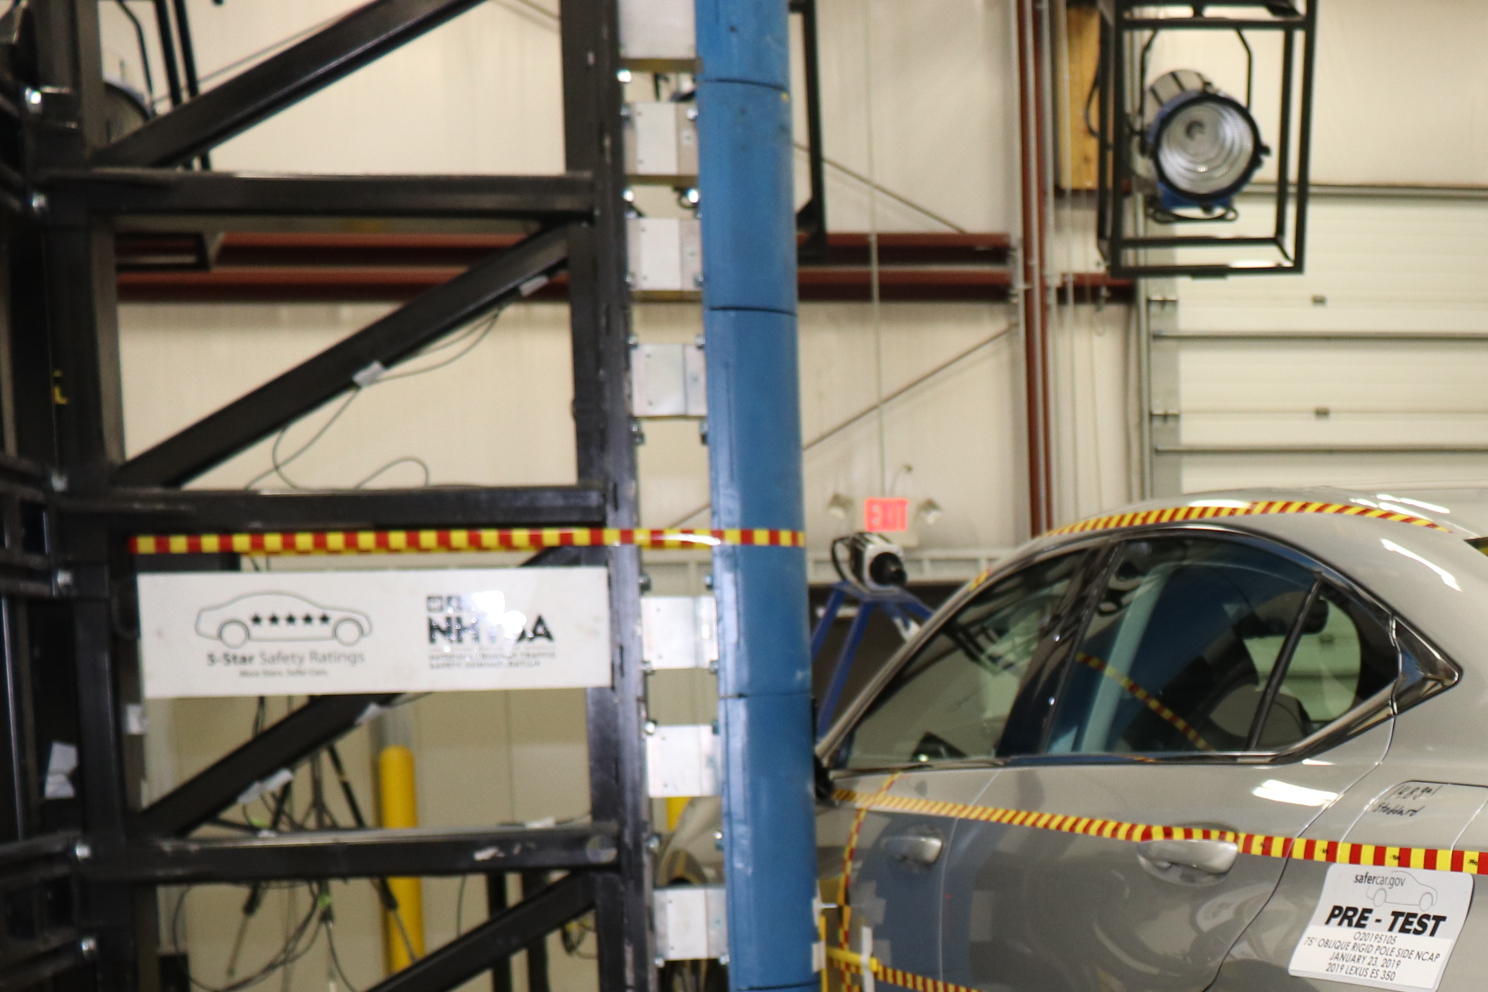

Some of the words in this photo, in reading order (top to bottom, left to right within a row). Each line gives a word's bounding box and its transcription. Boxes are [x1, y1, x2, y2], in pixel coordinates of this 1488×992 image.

[428, 613, 555, 643] NHA
[259, 651, 305, 667] Safety
[309, 650, 365, 667] Ratings
[1354, 872, 1406, 890] safercar.gov
[1325, 905, 1374, 929] PRE
[1388, 911, 1447, 937] TEST
[1318, 938, 1351, 951] OBLIQUE
[1352, 942, 1374, 954] RIGID
[1374, 945, 1396, 957] POLE
[1397, 948, 1415, 959] SIDE
[1415, 950, 1441, 963] NCAP
[1329, 952, 1367, 965] JANUARY
[1381, 958, 1401, 969] 2019
[1326, 963, 1345, 974] 2019
[1345, 965, 1370, 979] LEXUS
[1370, 969, 1380, 979] ES
[1380, 970, 1396, 982] 350
